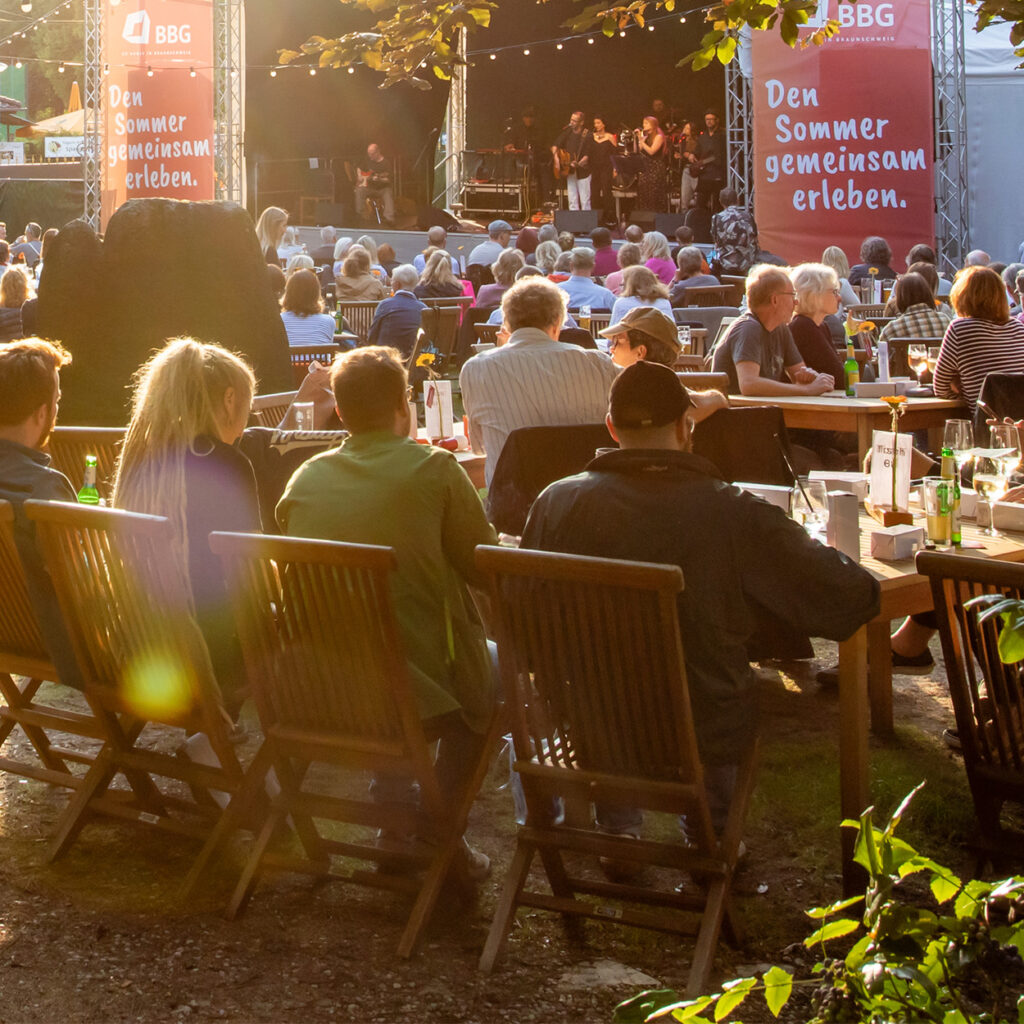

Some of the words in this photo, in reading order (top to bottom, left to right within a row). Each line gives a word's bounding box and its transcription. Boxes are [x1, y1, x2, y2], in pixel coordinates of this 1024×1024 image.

[838, 3, 895, 27] BBG
[155, 24, 192, 44] BBG
[108, 84, 143, 108] Den
[764, 79, 819, 109] Den
[114, 112, 187, 135] Sommer
[775, 114, 889, 143] Sommer
[107, 137, 211, 167] gemeinsam
[765, 146, 927, 183] gemeinsam
[125, 163, 198, 189] erleben.
[792, 178, 907, 211] erleben.
